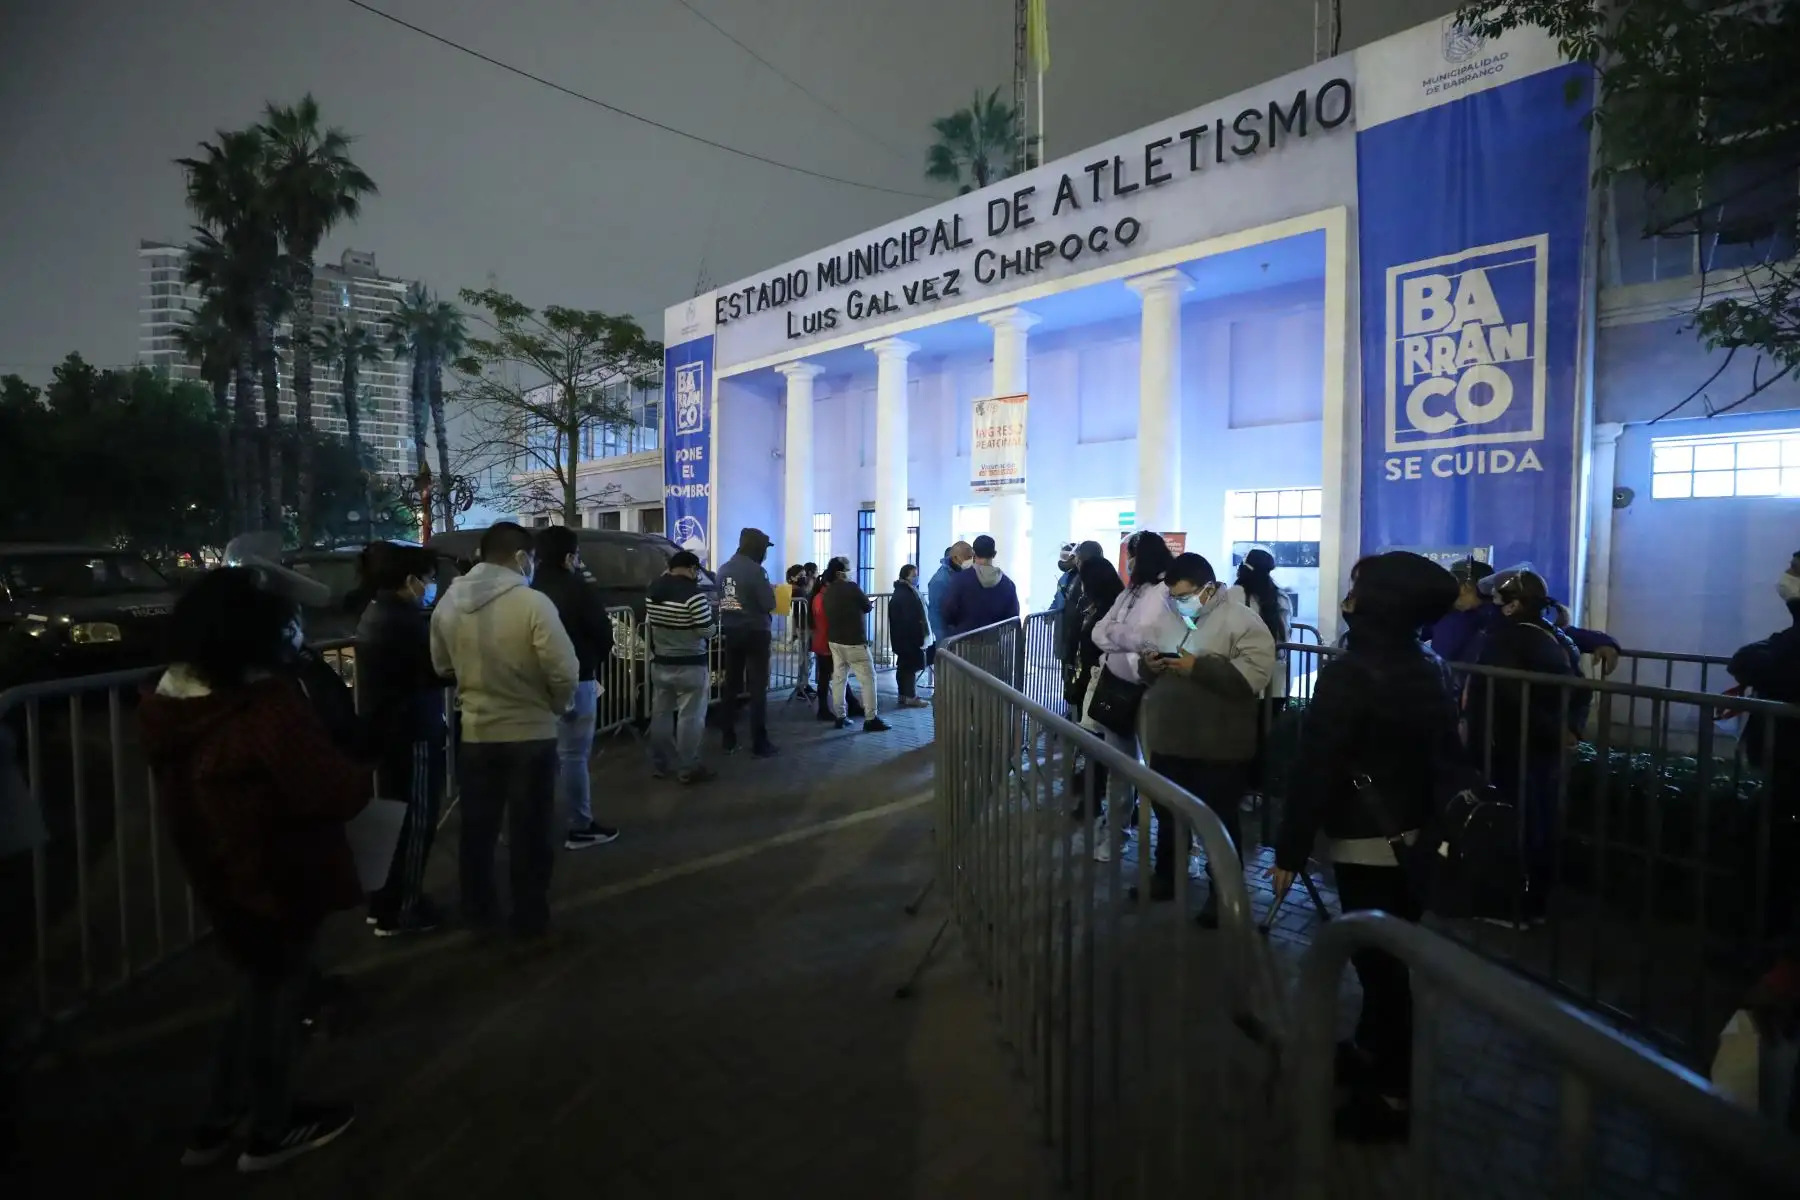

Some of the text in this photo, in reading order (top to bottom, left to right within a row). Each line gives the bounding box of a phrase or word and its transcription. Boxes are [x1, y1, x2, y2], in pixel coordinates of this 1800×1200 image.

[1422, 52, 1509, 87] MUNICIPALIDAD
[1426, 64, 1504, 96] DE BARRANCO
[715, 78, 1352, 325] ESTADIO MUNICIPAL DE ATLETISMO
[675, 446, 703, 462] PONE
[1385, 447, 1544, 481] SE CUIDA
[682, 465, 695, 478] EL
